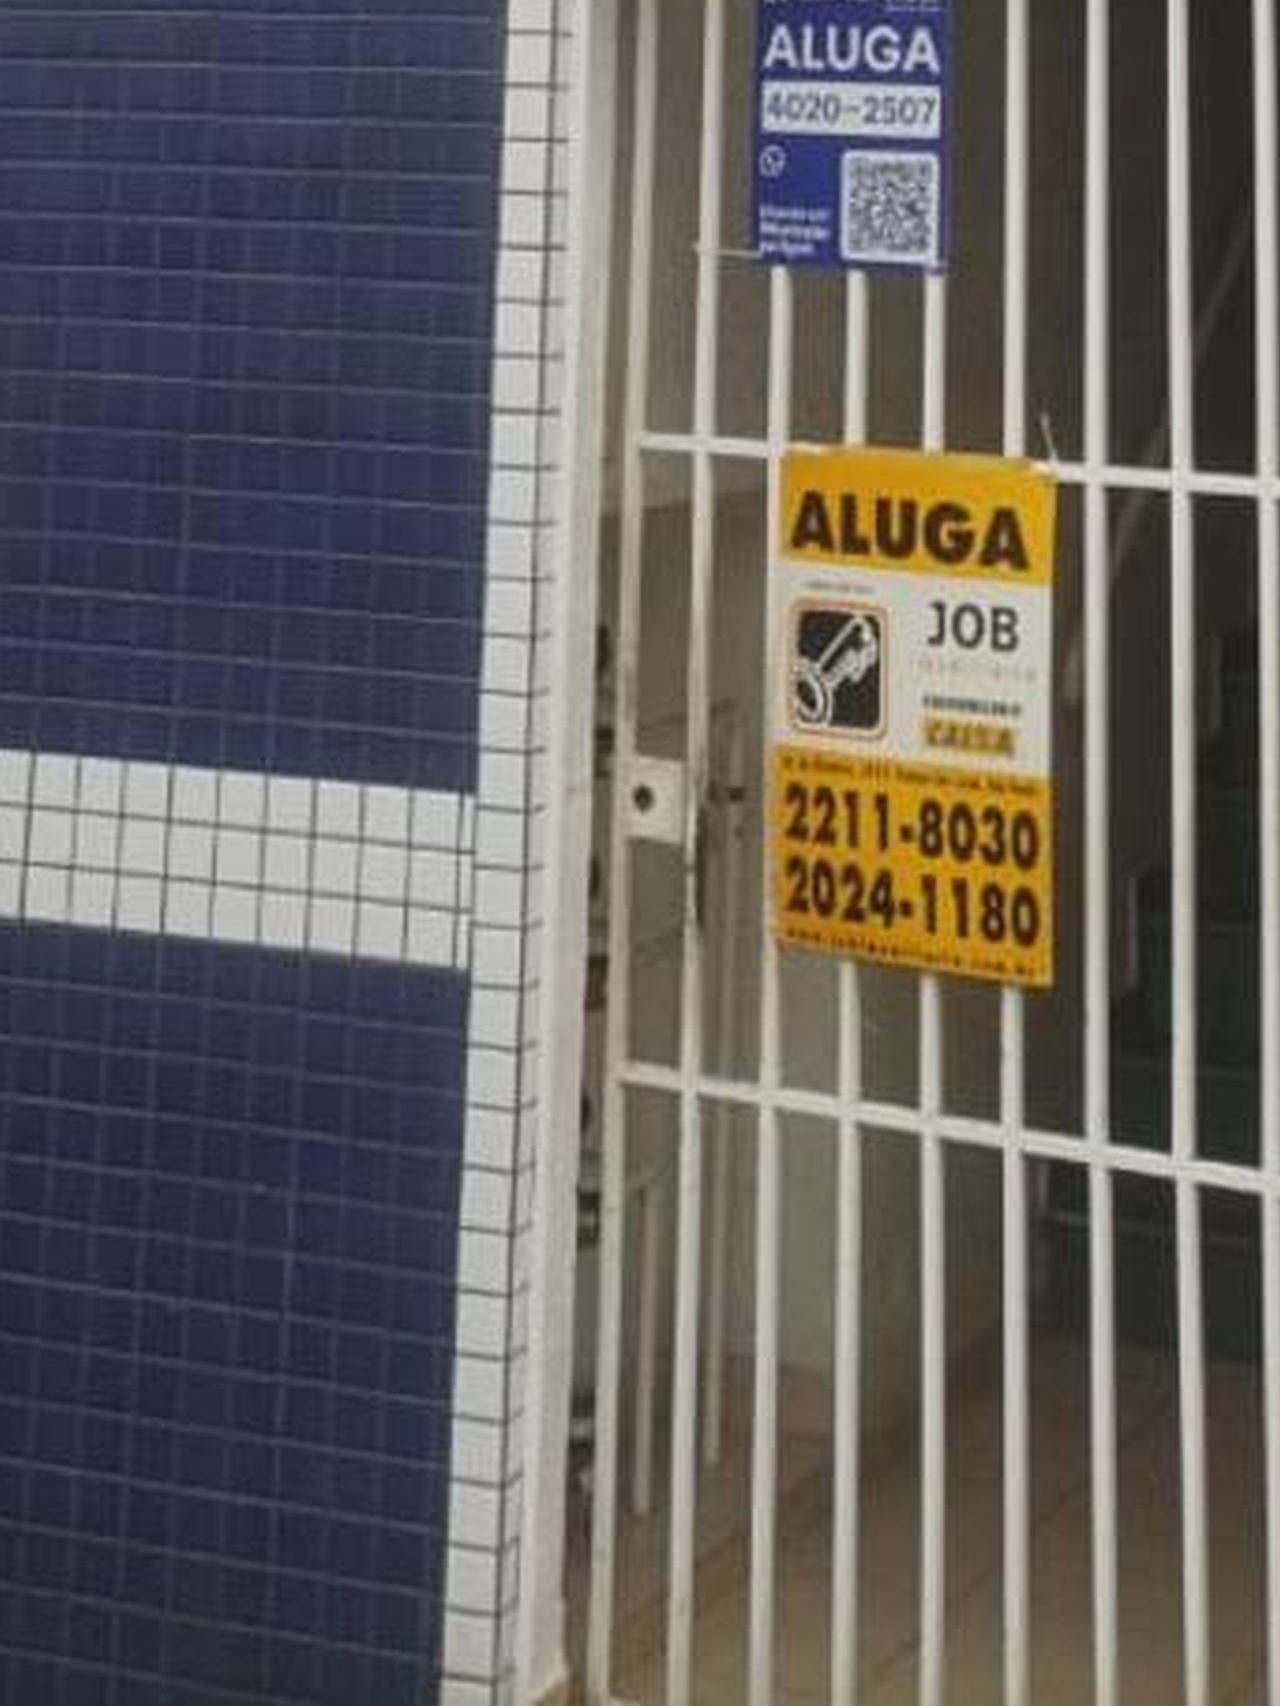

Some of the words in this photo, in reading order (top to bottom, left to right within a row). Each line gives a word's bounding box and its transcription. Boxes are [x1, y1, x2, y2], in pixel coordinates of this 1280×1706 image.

[763, 23, 941, 74] ALUGA
[767, 92, 938, 125] 4020-2507
[790, 490, 1029, 572] ALUGA
[927, 600, 1021, 652] JOB
[783, 783, 1040, 871] 2211-8030
[783, 855, 1041, 948] 2024-1180
